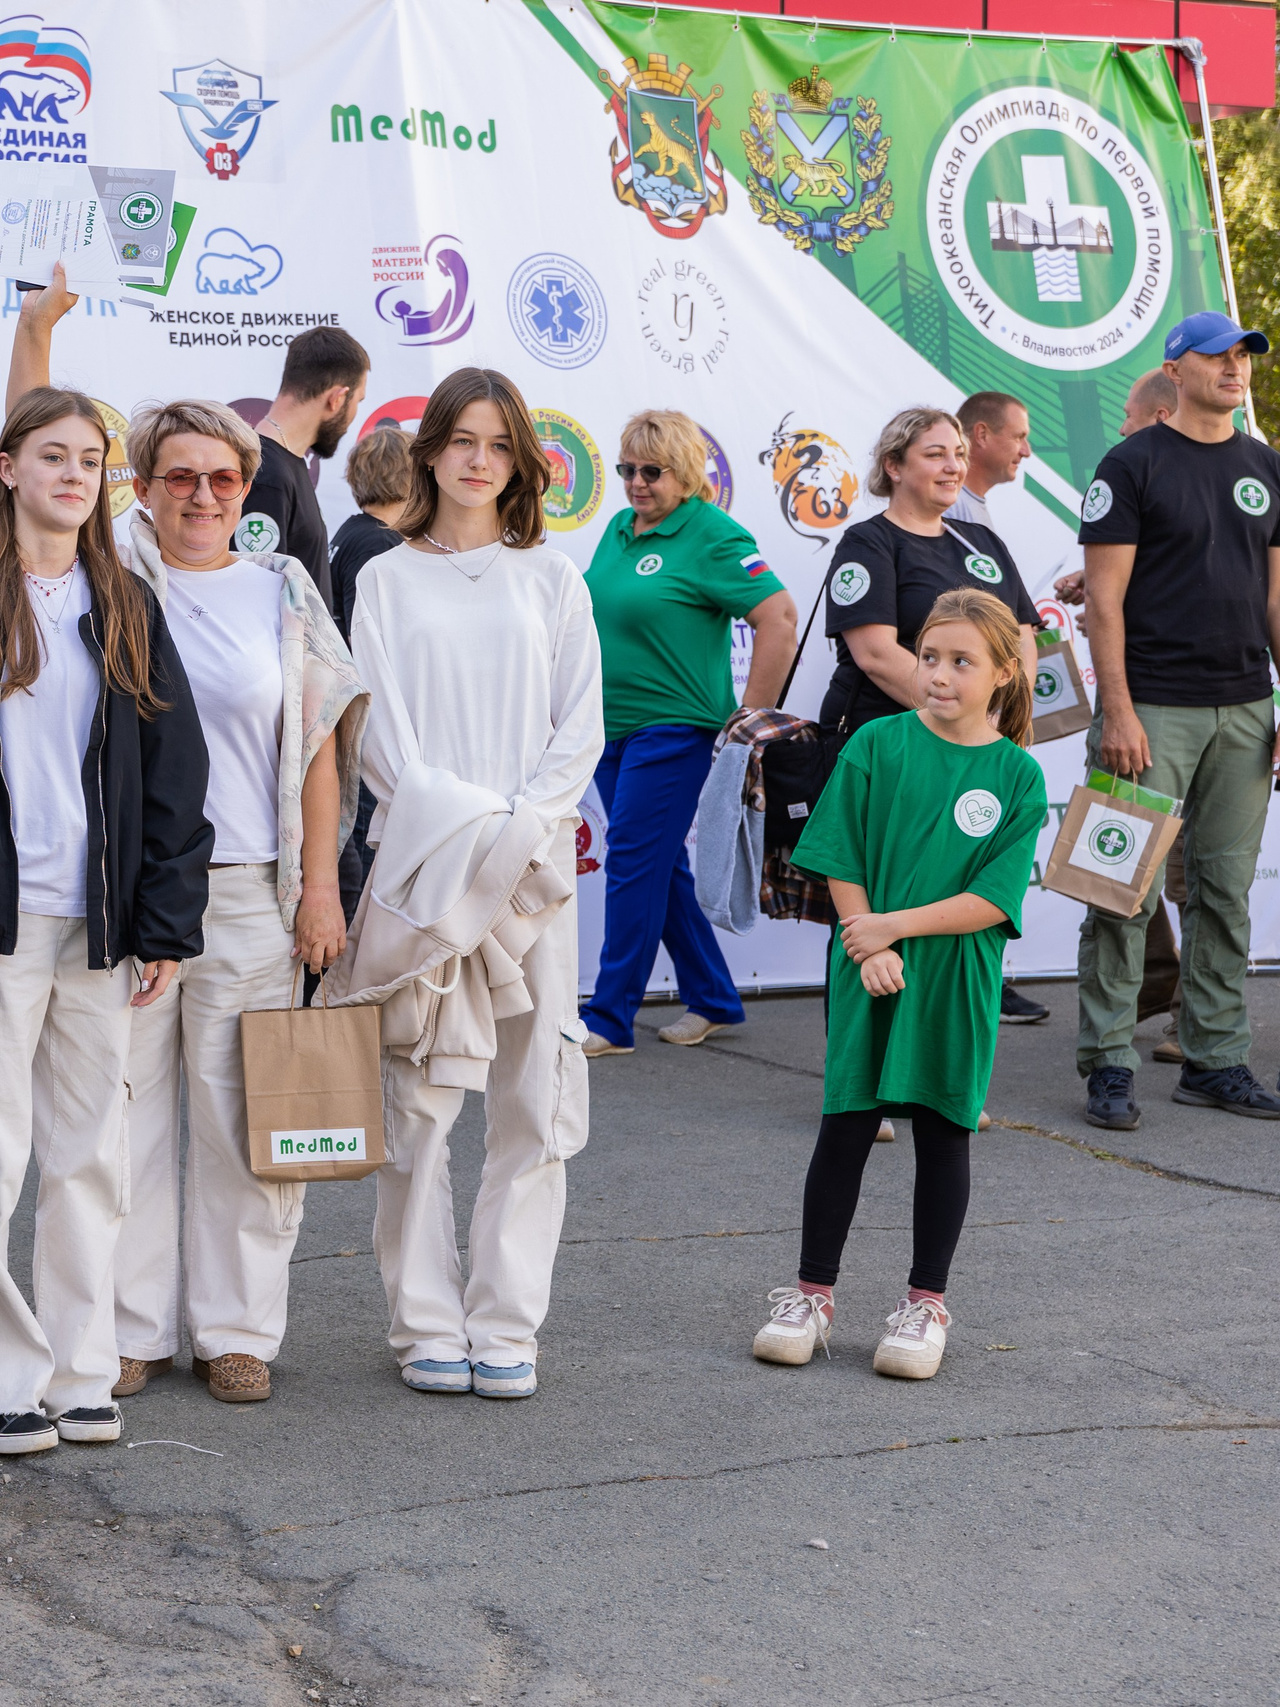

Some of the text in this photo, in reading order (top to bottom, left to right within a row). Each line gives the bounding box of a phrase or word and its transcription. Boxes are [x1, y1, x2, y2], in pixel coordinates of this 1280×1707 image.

[197, 88, 240, 99] СКОРАЯ ПОМОЩЬ
[331, 103, 497, 154] MedMod
[214, 152, 232, 171] 03
[83, 200, 98, 247] ГРАМОТА
[938, 99, 1162, 330] Тихоокеанская Олимпиада по первой помощи
[372, 246, 420, 254] ДВИЖЕНИЕ
[372, 258, 422, 267] МАТЕРИ
[373, 272, 424, 282] РОССИИ
[150, 310, 340, 328] ЖЕНСКОЕ ДВИЖЕНИЕ
[638, 258, 729, 374] real green real green
[169, 330, 241, 348] ЕДИНОЙ
[1011, 327, 1124, 357] г. Владивосток 2024
[539, 411, 573, 429] России
[575, 428, 587, 440] по
[576, 454, 602, 524] Владивостоку
[280, 1136, 357, 1155] MedMod
